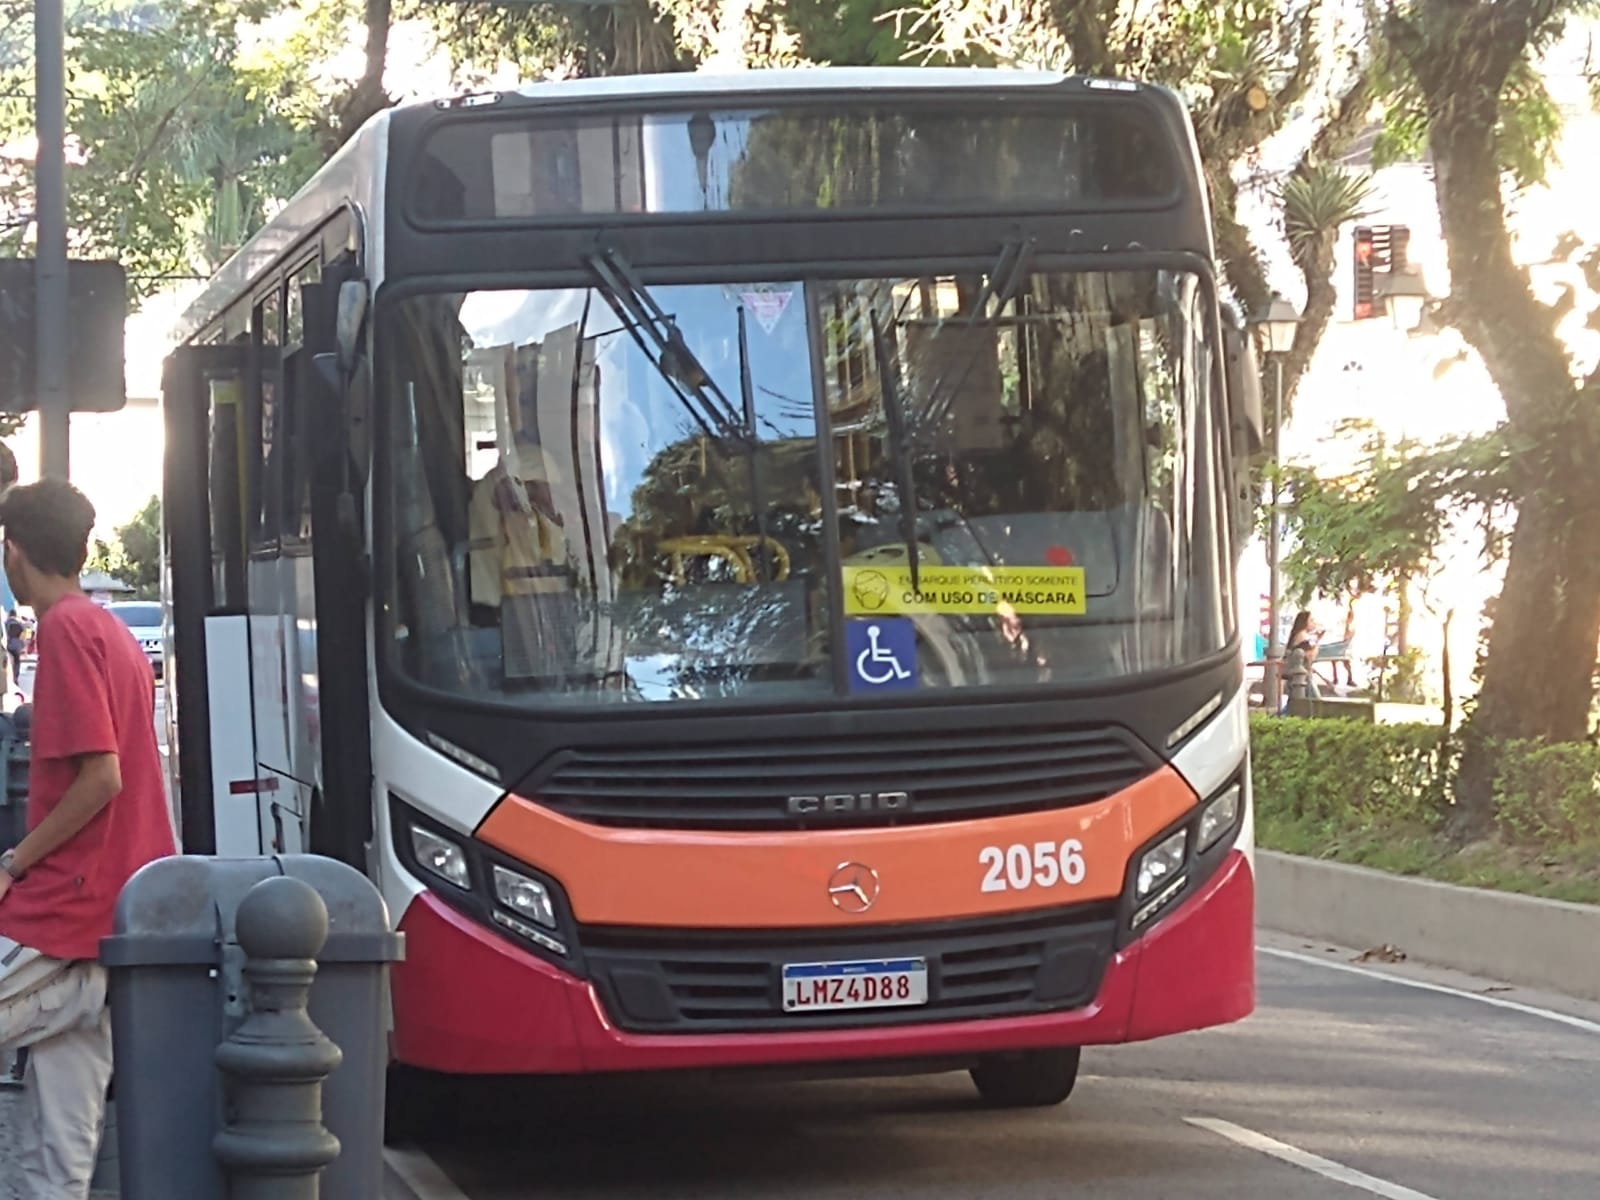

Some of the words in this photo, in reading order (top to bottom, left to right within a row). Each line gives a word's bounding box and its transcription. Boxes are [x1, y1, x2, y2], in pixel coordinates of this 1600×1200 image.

[1025, 574, 1078, 586] SOMENTE
[902, 591, 937, 604] COM
[941, 591, 973, 604] USO
[977, 591, 998, 604] DE
[1001, 589, 1077, 605] MÁSCARA
[979, 838, 1086, 892] 2056
[796, 974, 909, 1005] LMZ4D88
